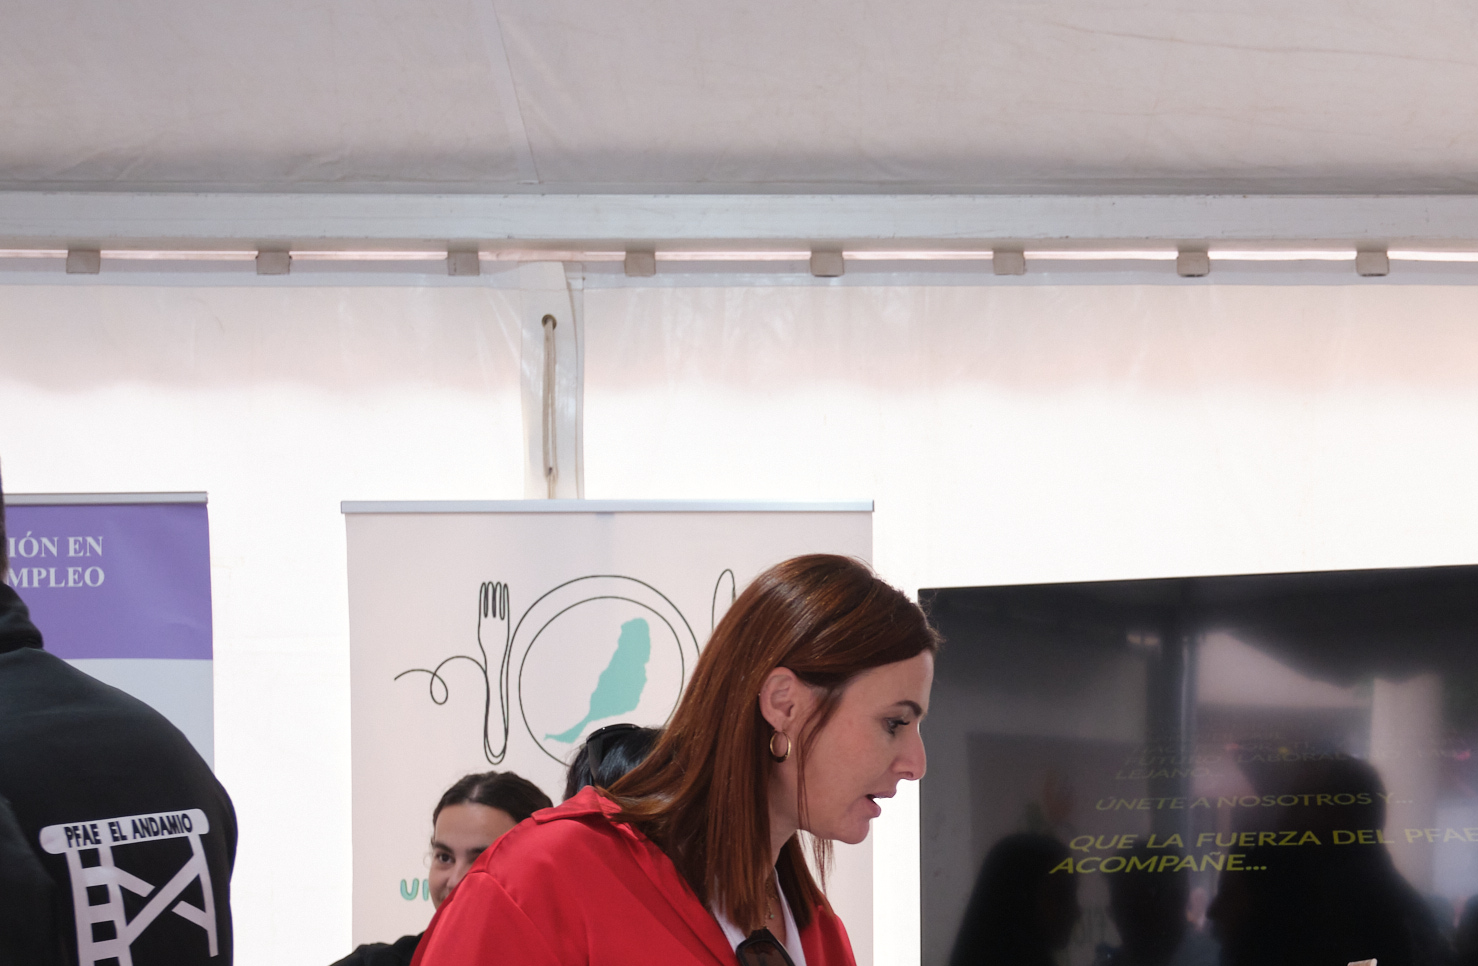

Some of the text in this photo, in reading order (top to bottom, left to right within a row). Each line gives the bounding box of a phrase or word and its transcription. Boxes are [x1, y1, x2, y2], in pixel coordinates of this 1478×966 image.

[67, 536, 103, 557] EN
[1190, 797, 1210, 809] A
[1216, 792, 1373, 809] NOSOTROS
[63, 813, 194, 849] PFAE EL ANDAMIO
[1069, 834, 1139, 852] QUE
[1146, 833, 1185, 849] LA
[1196, 829, 1322, 848] FUERZA
[1332, 829, 1395, 845] DEL
[1048, 851, 1268, 875] ACOMPAÑE...
